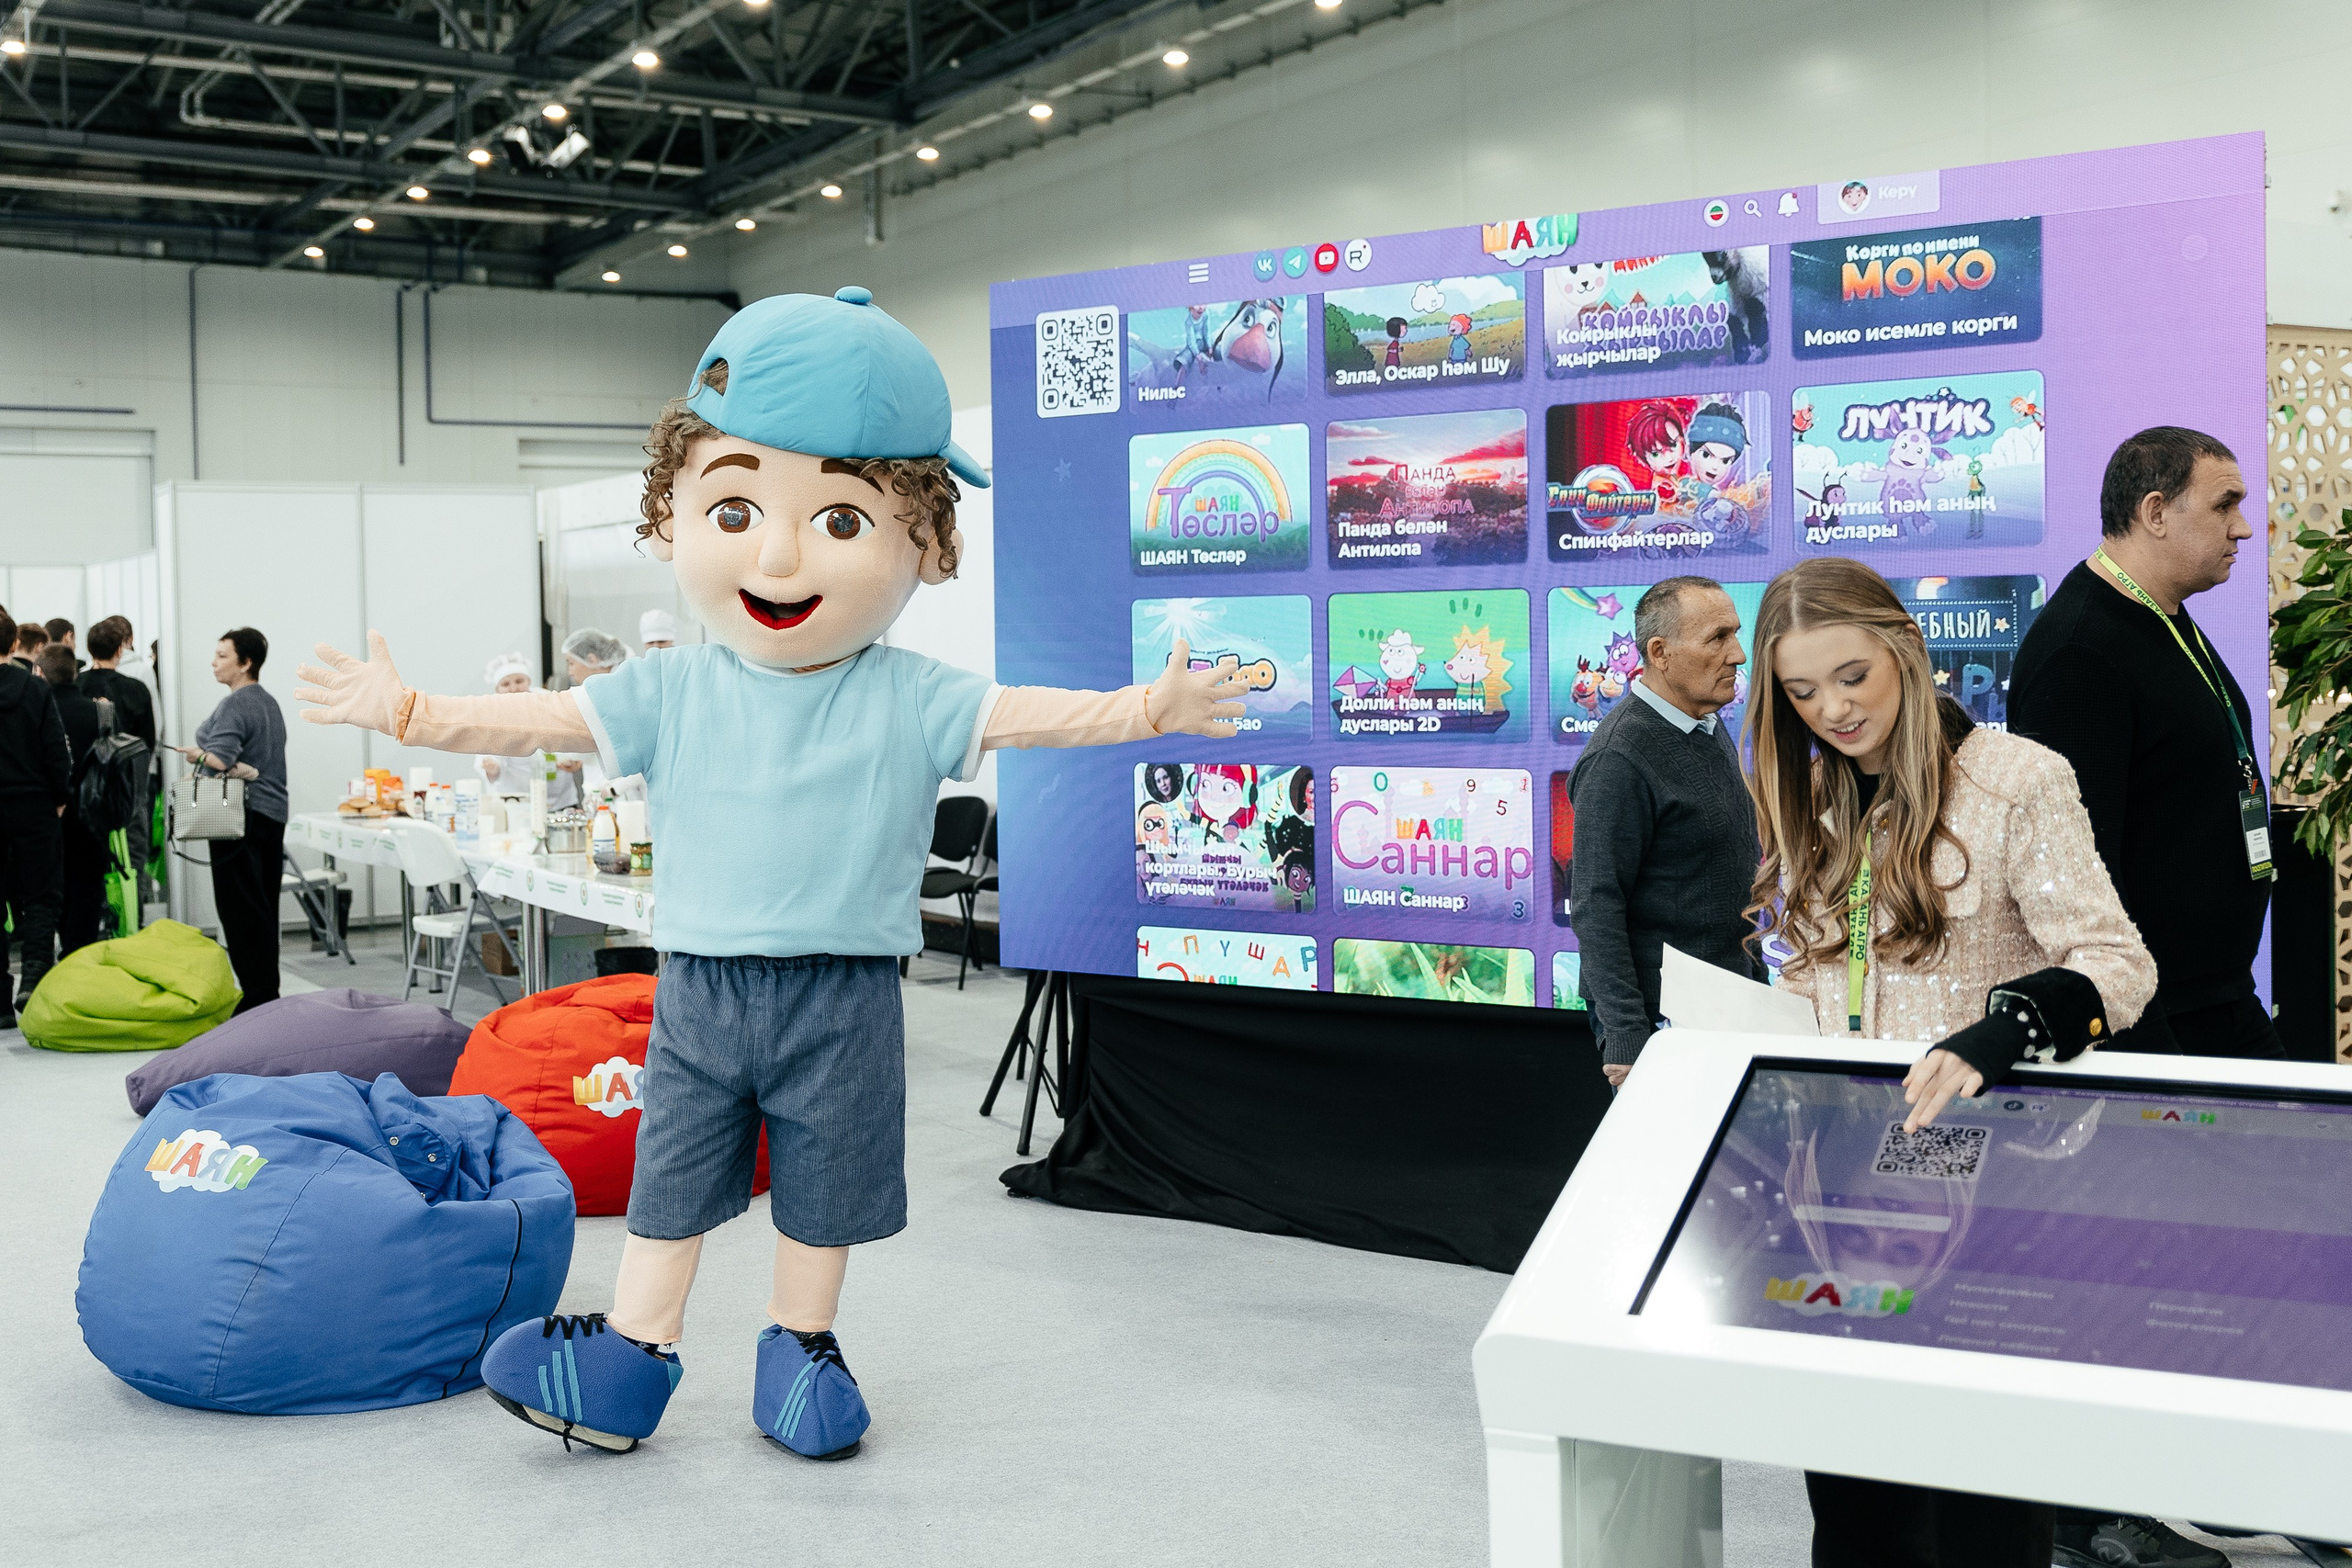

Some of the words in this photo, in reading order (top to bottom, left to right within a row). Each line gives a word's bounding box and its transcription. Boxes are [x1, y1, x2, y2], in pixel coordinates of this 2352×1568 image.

[1877, 185, 1918, 201] Керу
[1482, 213, 1578, 254] ШАЯН
[1846, 243, 1899, 262] Корги
[1902, 241, 1923, 256] по
[1925, 234, 1980, 254] имени
[1841, 248, 1997, 302] МОКО
[1556, 323, 1657, 345] Койрыклы
[1804, 328, 1860, 347] Моко
[1865, 321, 1947, 342] исемле
[1951, 314, 2018, 337] корги
[1335, 368, 1382, 385] Элла,
[1384, 365, 1438, 381] Оскар
[1442, 360, 1477, 377] һәм
[1481, 355, 1510, 376] Шу
[1138, 386, 1186, 401] Нильс
[1157, 485, 1280, 542] Төсләр
[1195, 494, 1239, 513] ШАЯН
[1806, 499, 1883, 520] Лунтик
[1889, 496, 1932, 514] һәм
[1937, 496, 1996, 513] аның
[1338, 521, 1391, 538] Панда
[1395, 518, 1448, 536] белән
[1806, 523, 1898, 543] дуслары
[1338, 542, 1422, 558] Антилопа
[1559, 530, 1714, 551] Спинфайтерлар
[1140, 549, 1188, 566] ШАЯН
[1191, 548, 1247, 566] Төсләр
[1910, 608, 1992, 638] ЕБНЫЙ
[1340, 695, 1395, 713] Долли
[1398, 694, 1432, 711] һәм
[1436, 697, 1485, 713] аның
[1340, 718, 1414, 735] дуслары
[1417, 716, 1442, 732] 2D
[1496, 799, 1508, 816] 5
[1396, 818, 1464, 841] ШАЯН
[1332, 800, 1533, 890] Саннар
[1146, 862, 1223, 878] кортлары.
[1227, 863, 1278, 880] Бурыч
[1146, 881, 1216, 897] үтәләчәк
[1343, 888, 1396, 906] ШАЯН
[1399, 890, 1464, 912] Саннар
[1512, 900, 1524, 919] 3
[1858, 880, 1869, 927] КААНЬ
[1856, 930, 1866, 961] АГРО
[144, 1138, 269, 1190] ШАЯН
[1763, 1277, 1916, 1315] ШАЯН
